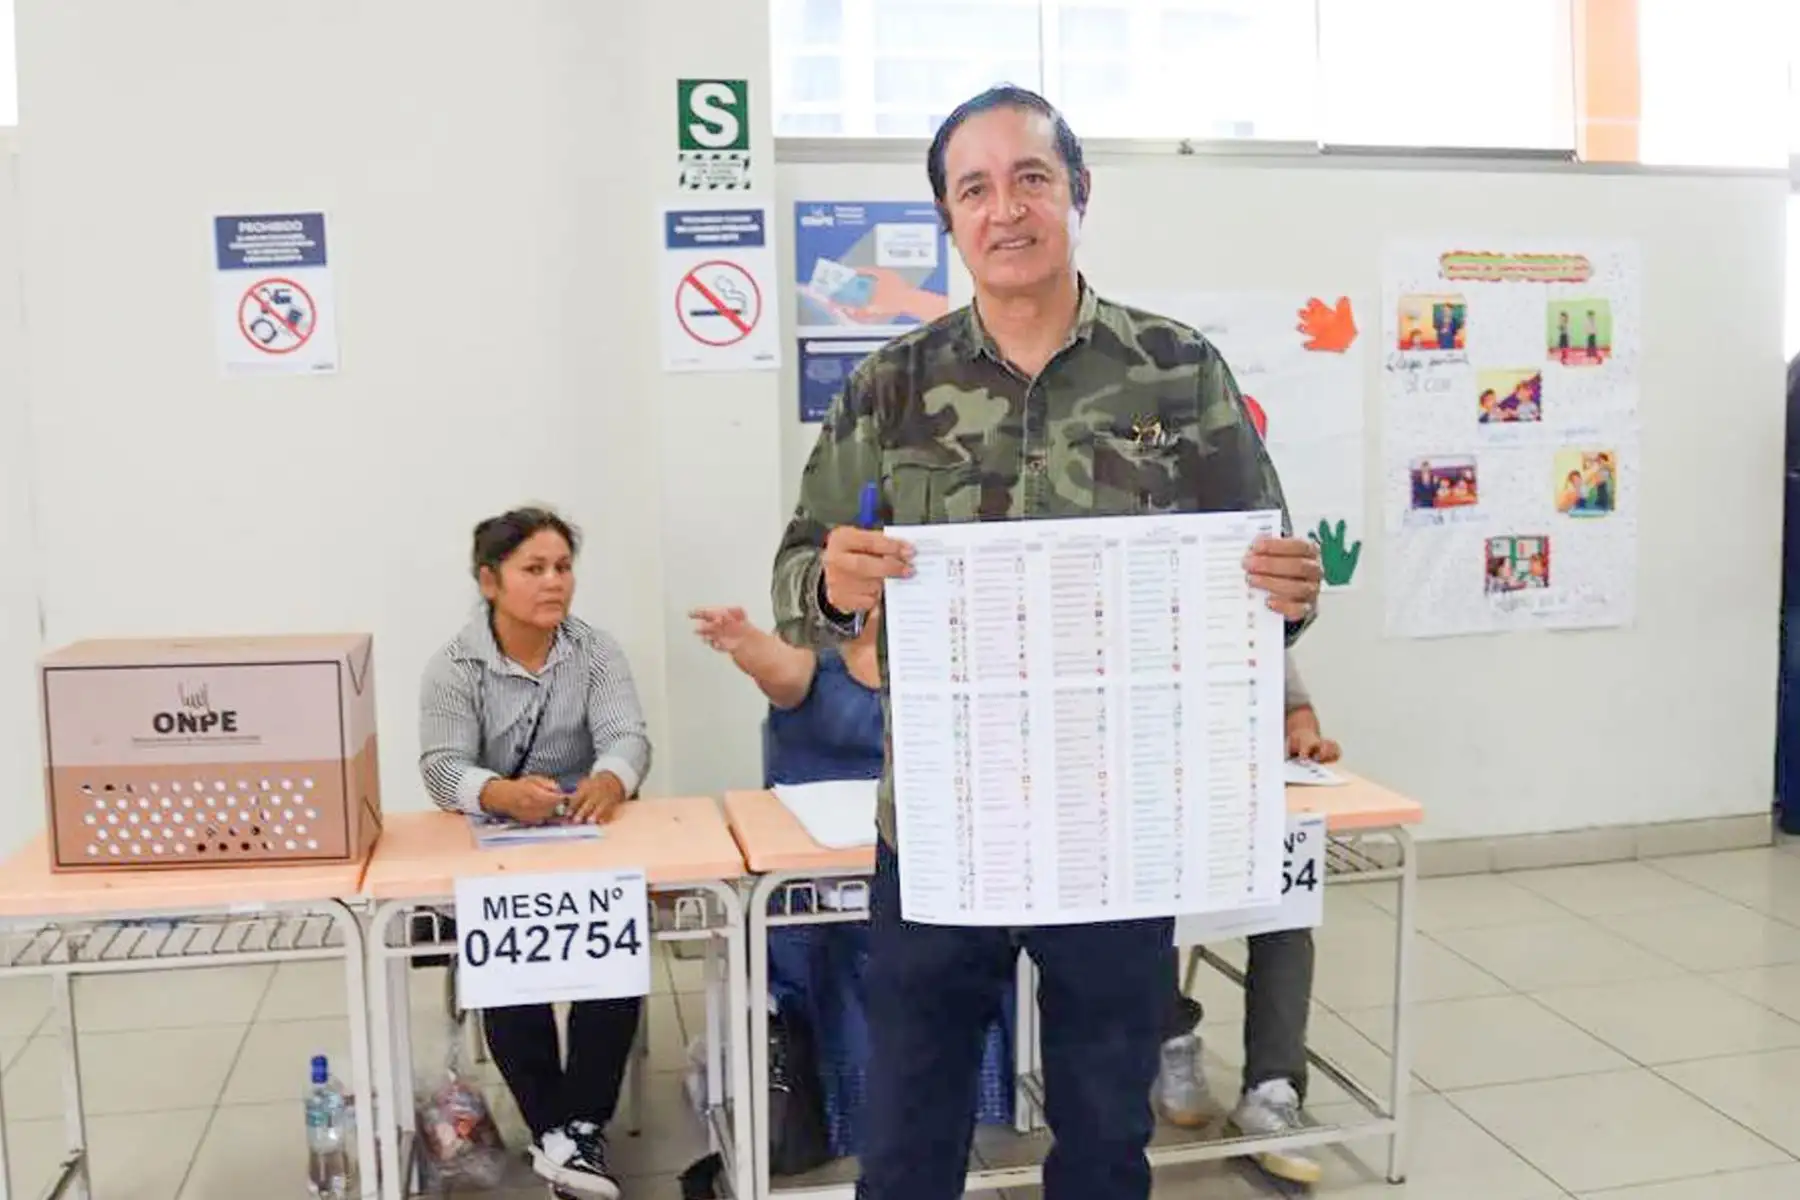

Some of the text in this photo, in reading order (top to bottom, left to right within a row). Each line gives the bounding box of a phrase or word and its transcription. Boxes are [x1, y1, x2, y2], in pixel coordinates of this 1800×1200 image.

[688, 83, 739, 148] S
[153, 710, 238, 734] ONPE
[483, 892, 579, 920] MESA
[465, 918, 642, 967] 042754
